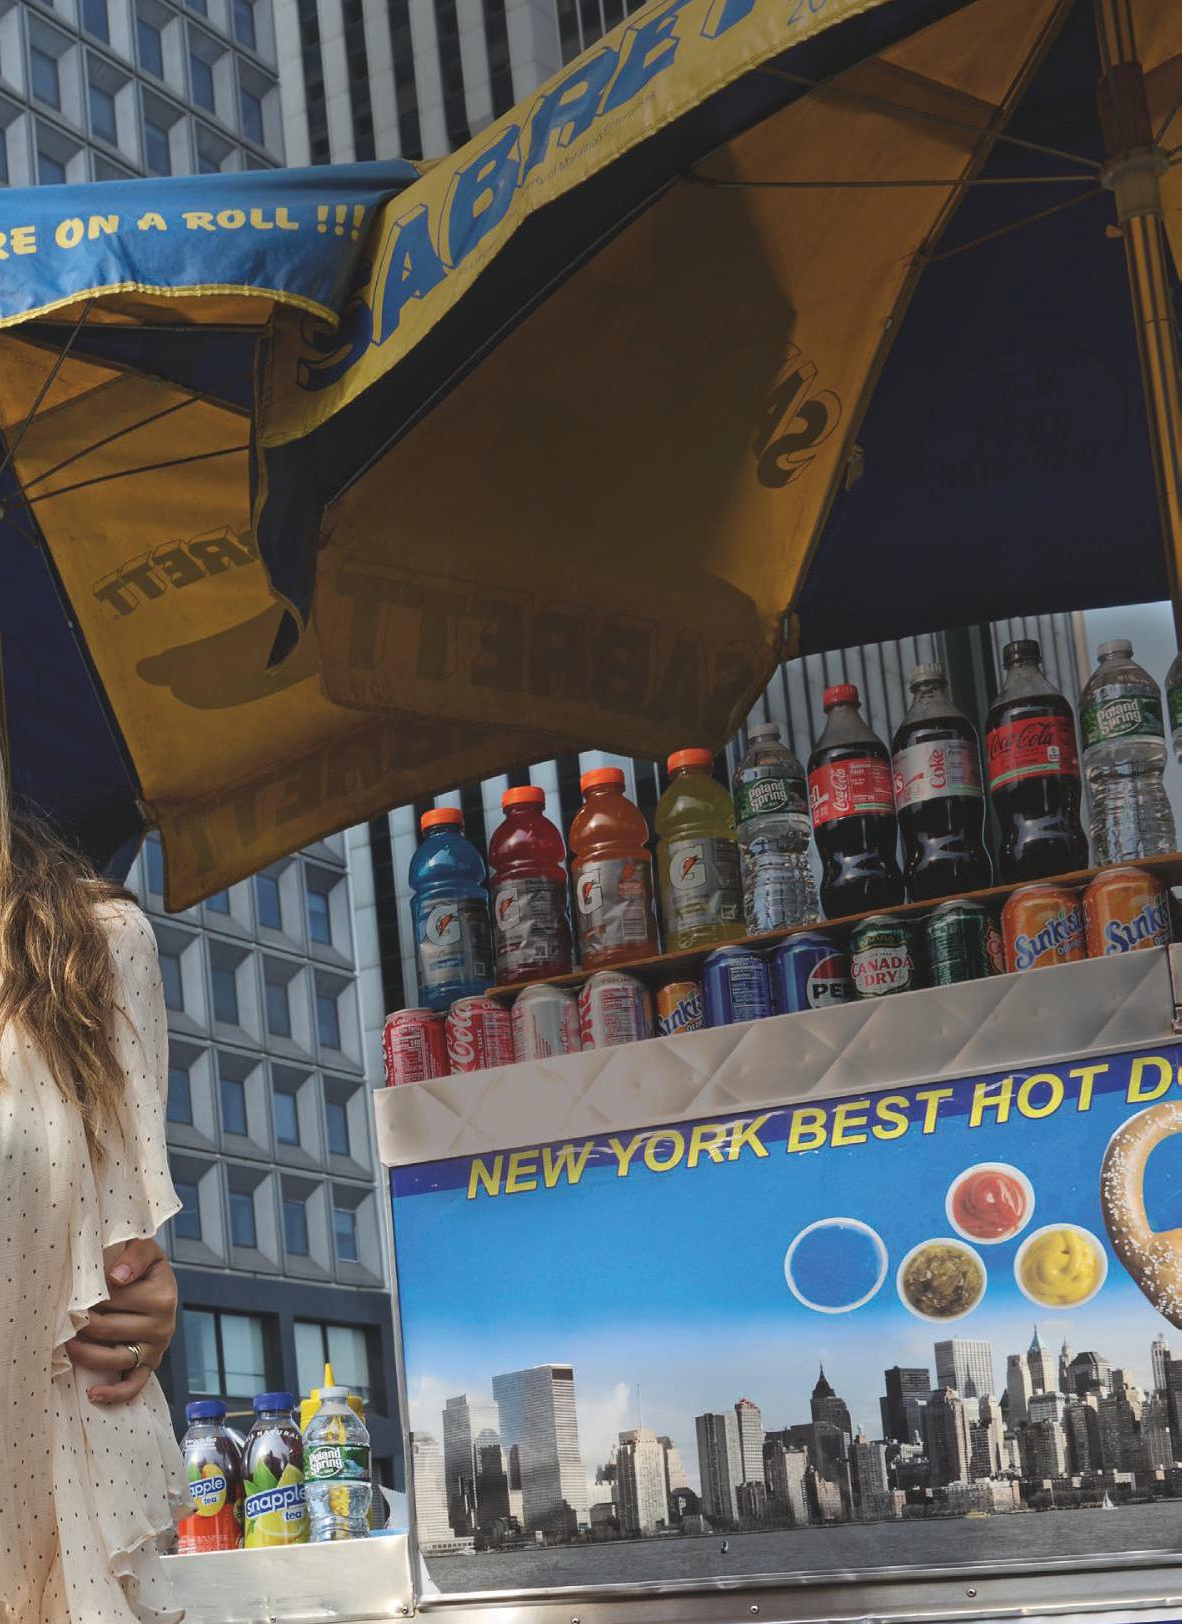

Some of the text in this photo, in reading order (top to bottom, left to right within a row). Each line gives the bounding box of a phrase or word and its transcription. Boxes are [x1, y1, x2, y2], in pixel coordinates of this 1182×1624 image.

[55, 214, 119, 249] ON
[138, 212, 167, 231] A
[185, 206, 300, 232] ROLL
[1097, 698, 1139, 719] Poland
[1098, 711, 1142, 735] Spring
[930, 749, 946, 789] Coke
[748, 778, 786, 800] Poland
[750, 790, 788, 812] Spring
[670, 844, 708, 890] G
[576, 869, 604, 915] G
[495, 887, 521, 931] G
[426, 903, 462, 946] G
[851, 954, 913, 977] CANADA
[865, 971, 898, 987] DRY
[467, 1056, 1182, 1201] NEW YORK BEST HOT D
[309, 1447, 342, 1464] Poland
[309, 1457, 344, 1474] Spring
[189, 1477, 224, 1497] apple
[203, 1496, 217, 1506] tea
[246, 1484, 306, 1515] snapple
[284, 1511, 302, 1521] tea
